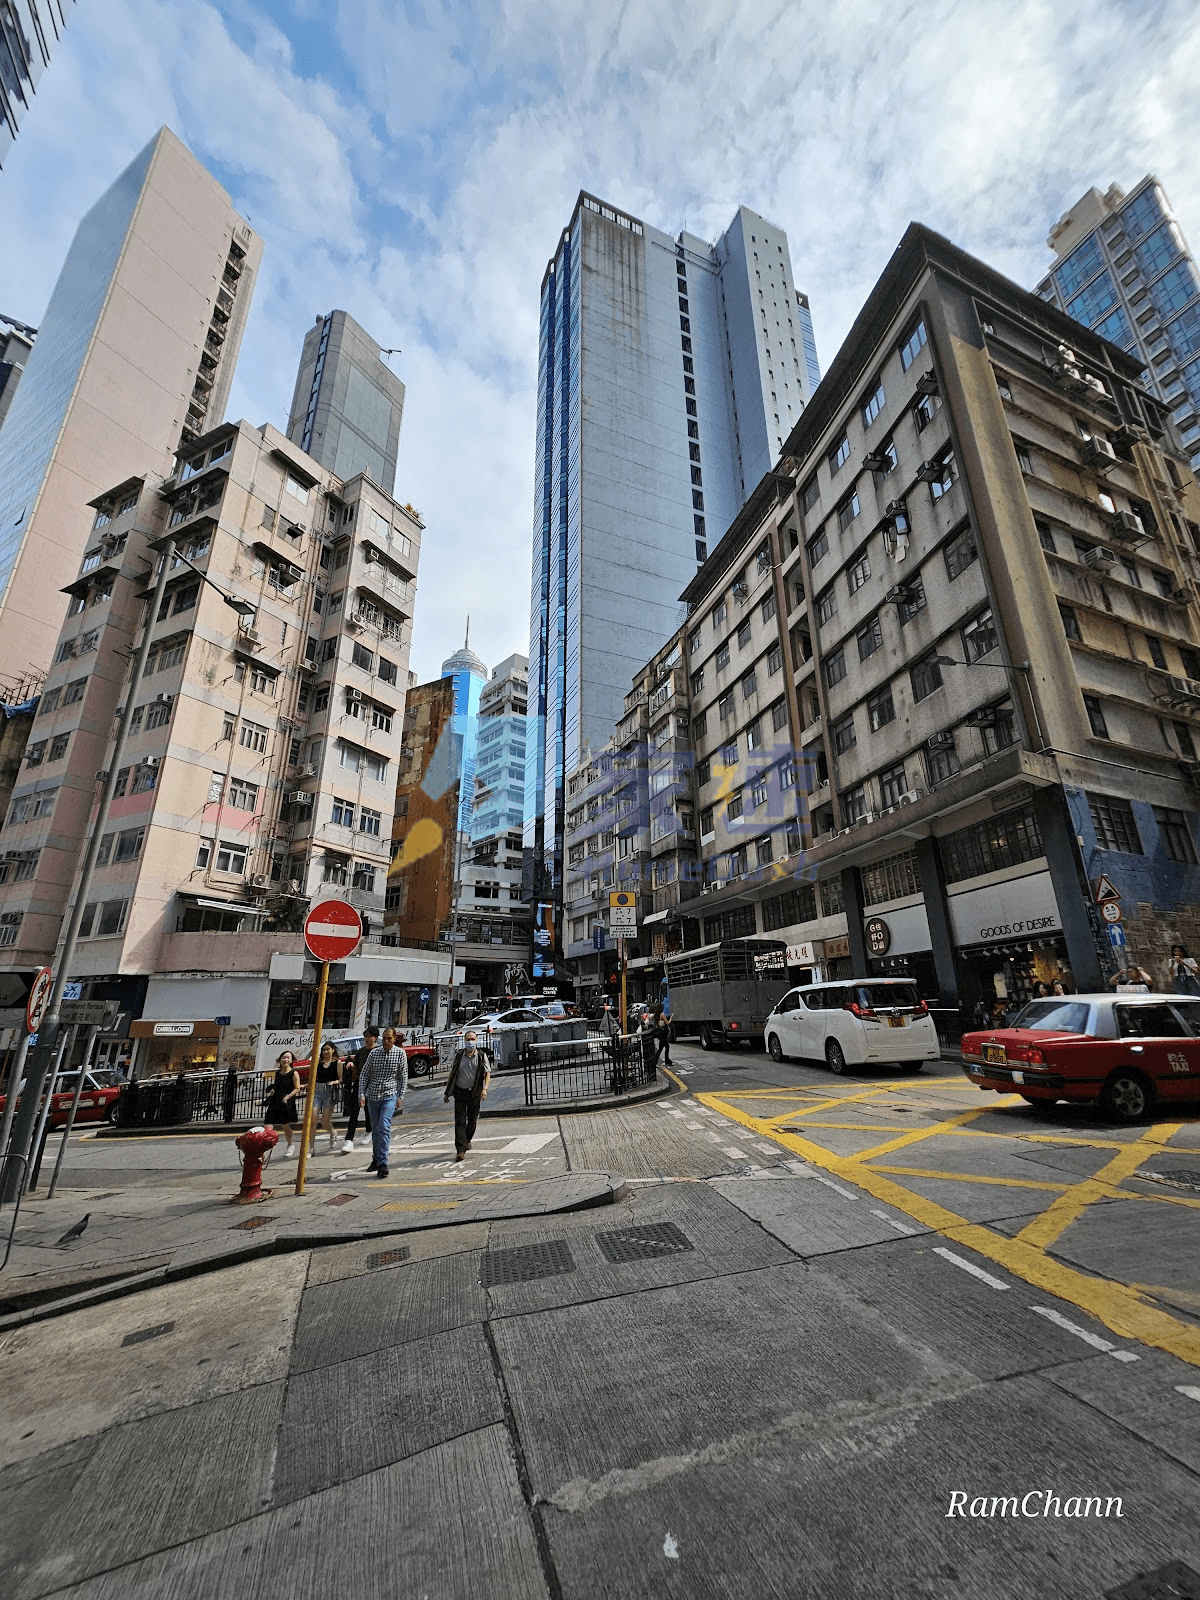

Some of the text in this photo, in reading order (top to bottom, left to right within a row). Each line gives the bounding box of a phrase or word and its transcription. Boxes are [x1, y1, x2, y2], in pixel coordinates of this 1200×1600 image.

[980, 916, 1056, 939] GOODS OF DESIRE
[62, 1001, 104, 1010] Lyndhurst Terrace
[265, 1032, 295, 1046] Cause
[1170, 1061, 1190, 1072] TAXI
[397, 1156, 562, 1171] LOOK LEFT
